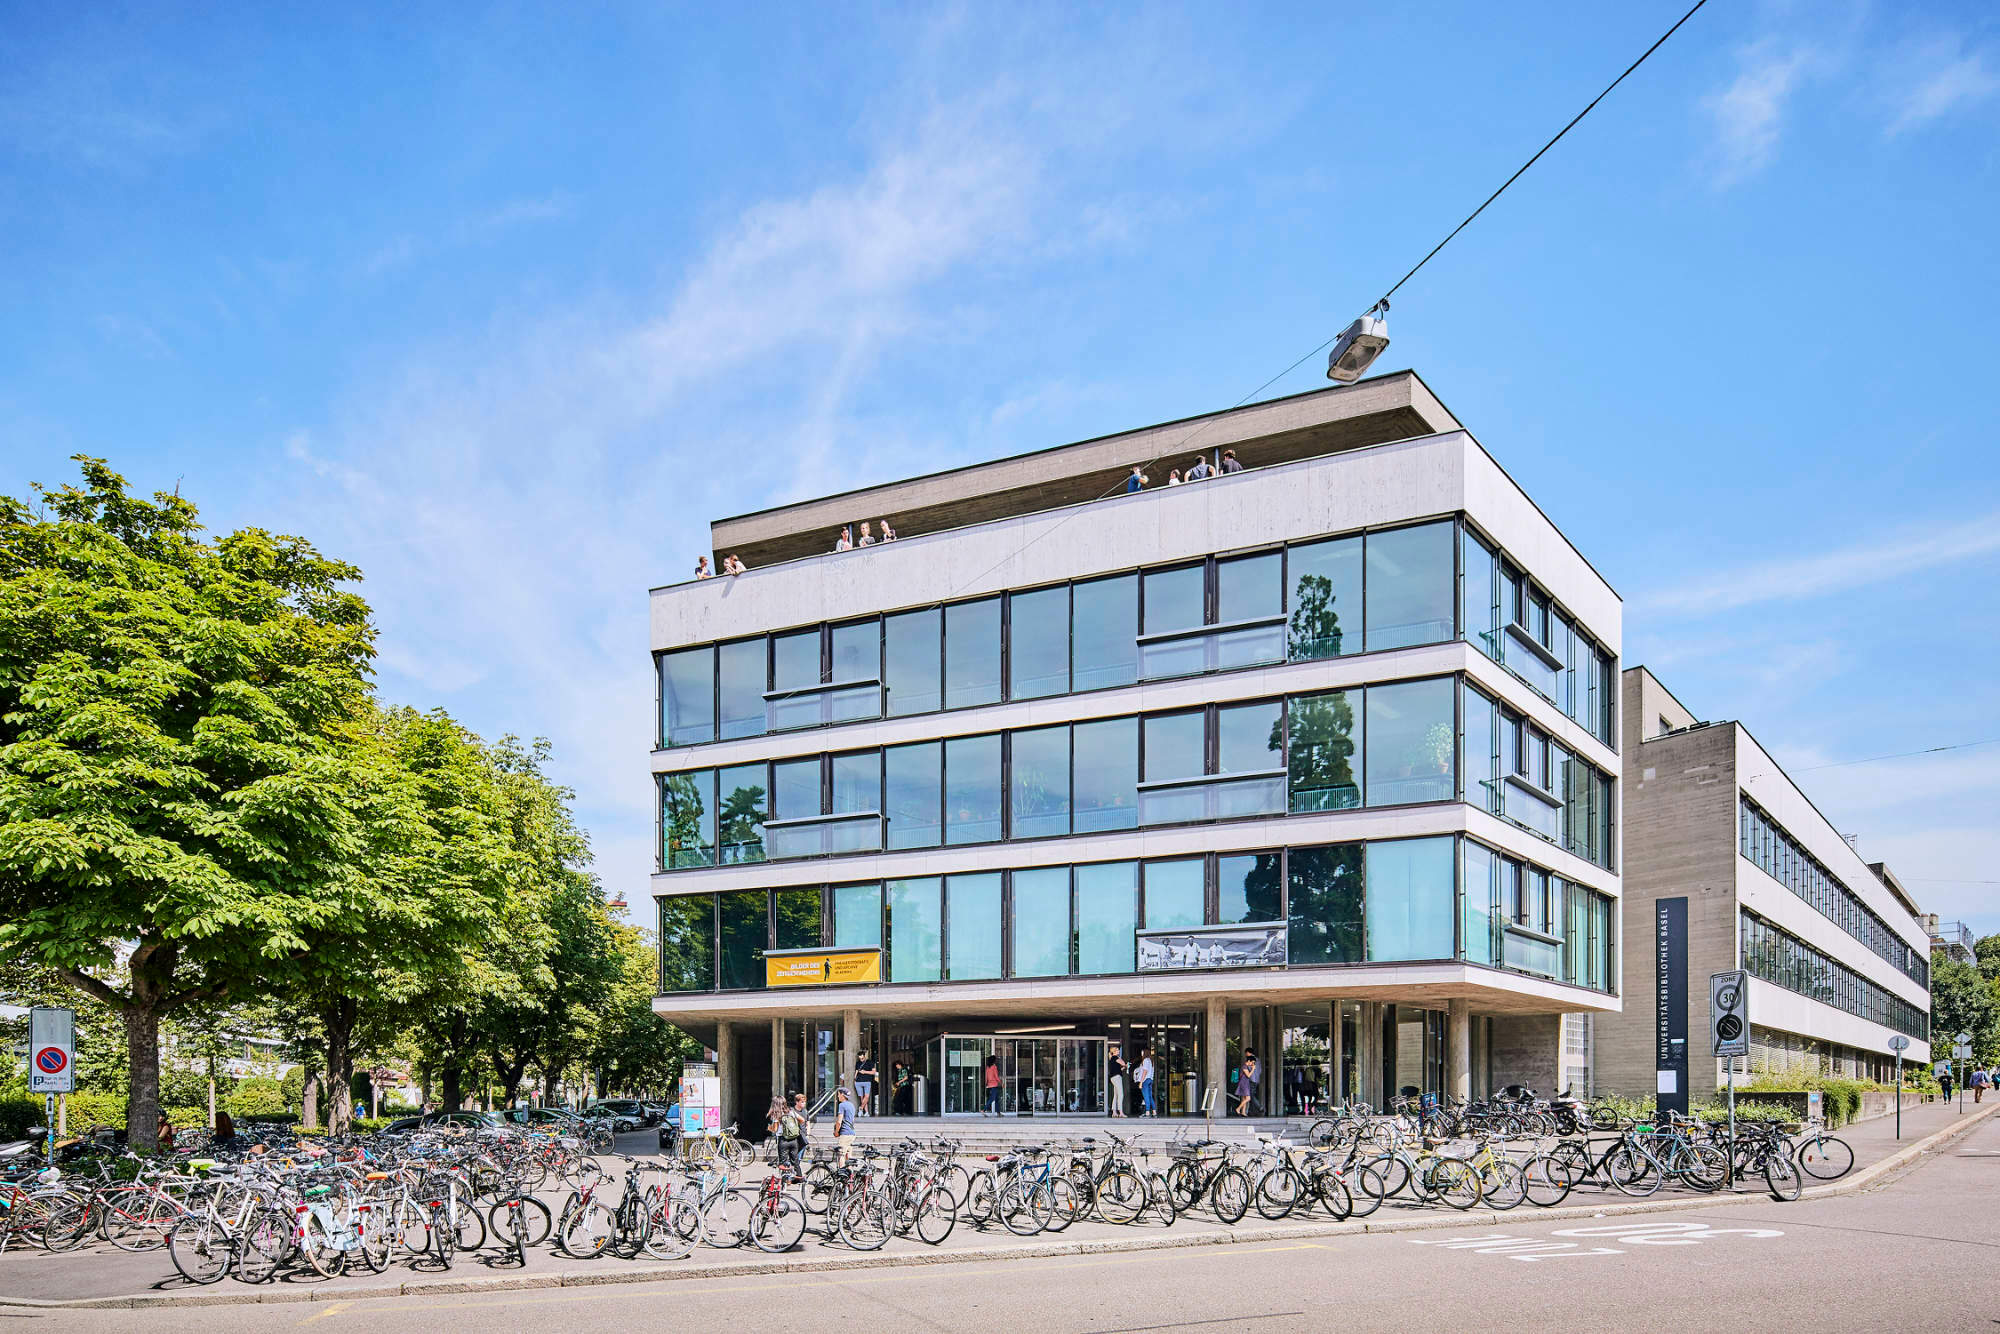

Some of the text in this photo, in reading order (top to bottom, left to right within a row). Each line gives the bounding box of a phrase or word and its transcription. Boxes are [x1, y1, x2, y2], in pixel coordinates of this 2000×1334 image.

[1660, 908, 1669, 1059] UNIVERSITÄTSBIBLIOTHEK BASEL
[1723, 992, 1735, 1003] 30
